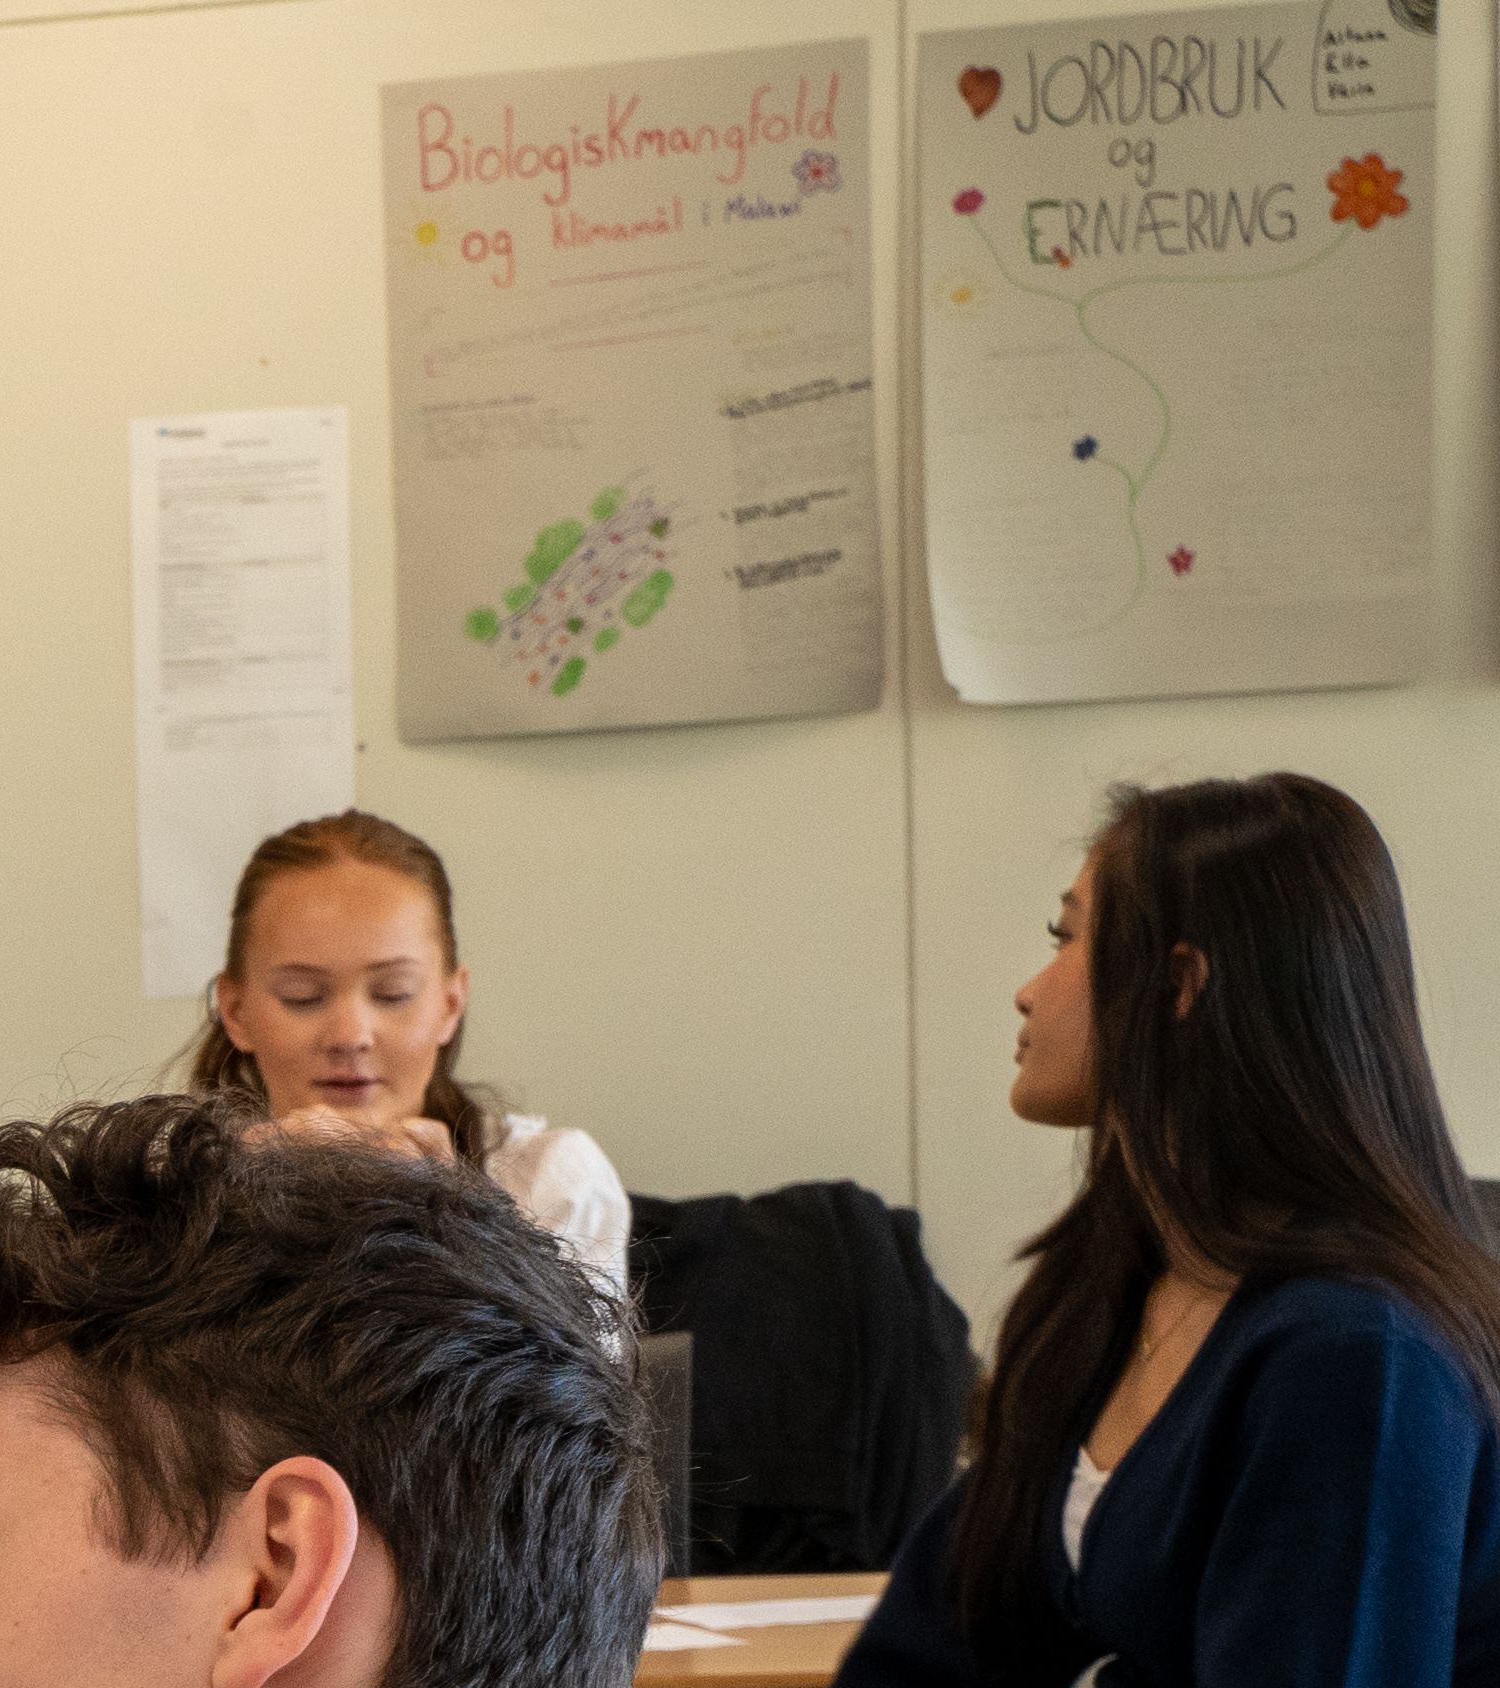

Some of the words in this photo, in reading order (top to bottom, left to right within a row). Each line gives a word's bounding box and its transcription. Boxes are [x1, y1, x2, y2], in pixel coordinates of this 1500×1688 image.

[1014, 35, 1288, 135] JORDBRUK
[1107, 137, 1158, 189] og
[461, 229, 515, 290] og
[1025, 182, 1298, 265] ERNÆRING
